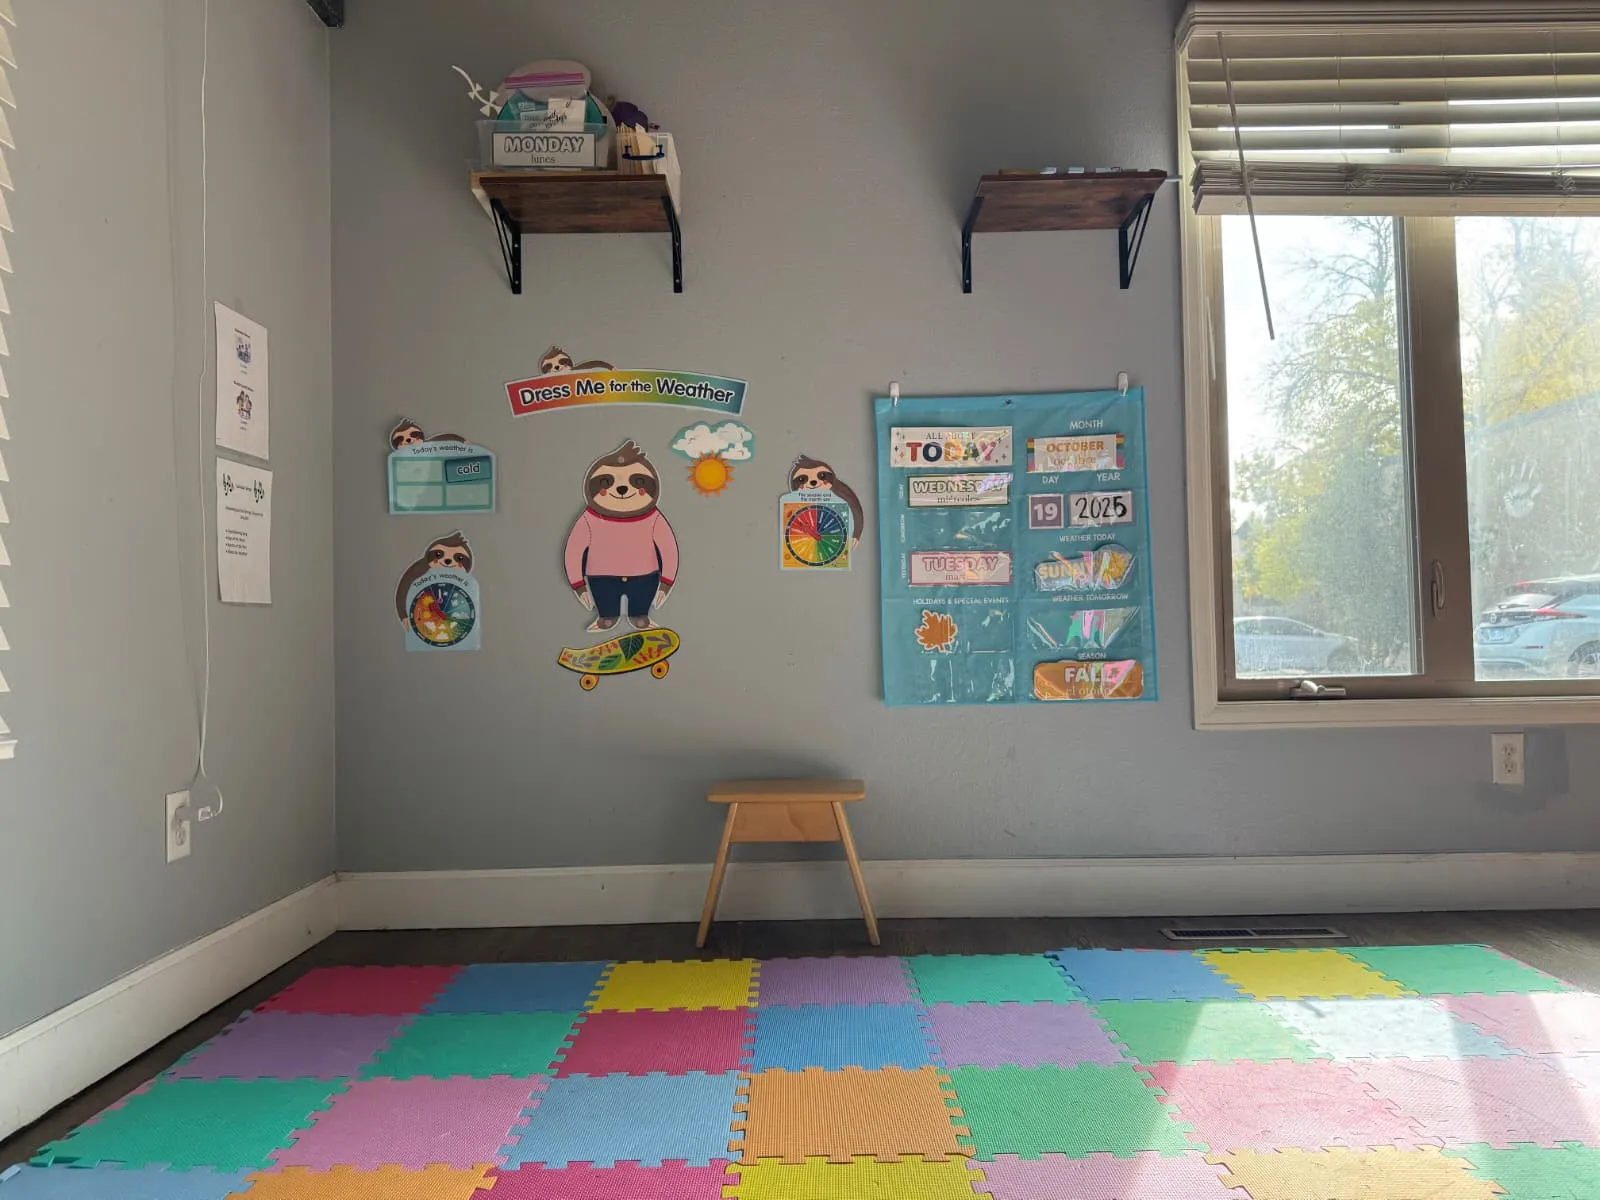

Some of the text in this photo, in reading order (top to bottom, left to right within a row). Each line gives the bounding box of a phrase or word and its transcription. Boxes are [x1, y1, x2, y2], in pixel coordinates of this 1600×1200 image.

[504, 136, 584, 153] MONDAY
[531, 154, 556, 164] lunes
[520, 378, 733, 405] Dress Me for the Weather
[1070, 420, 1103, 430] MONTH
[926, 431, 943, 440] ALL
[906, 441, 996, 462] TODAY
[1046, 440, 1104, 453] OCTOBER
[457, 461, 480, 474] cold
[1042, 475, 1059, 484] DAY
[1097, 472, 1120, 482] YEAR
[913, 479, 1002, 494] WEDNES
[1033, 503, 1058, 521] 19
[1075, 496, 1127, 519] 2025
[1059, 533, 1116, 543] WEATHER TODAY
[922, 556, 998, 571] TUESDAY
[1039, 561, 1102, 582] SUNN
[913, 598, 945, 606] HOLIDAYS
[954, 597, 982, 606] SPECIAL
[984, 596, 1009, 605] EVENTS
[1078, 652, 1106, 660] SEASON
[1065, 667, 1113, 683] FALL
